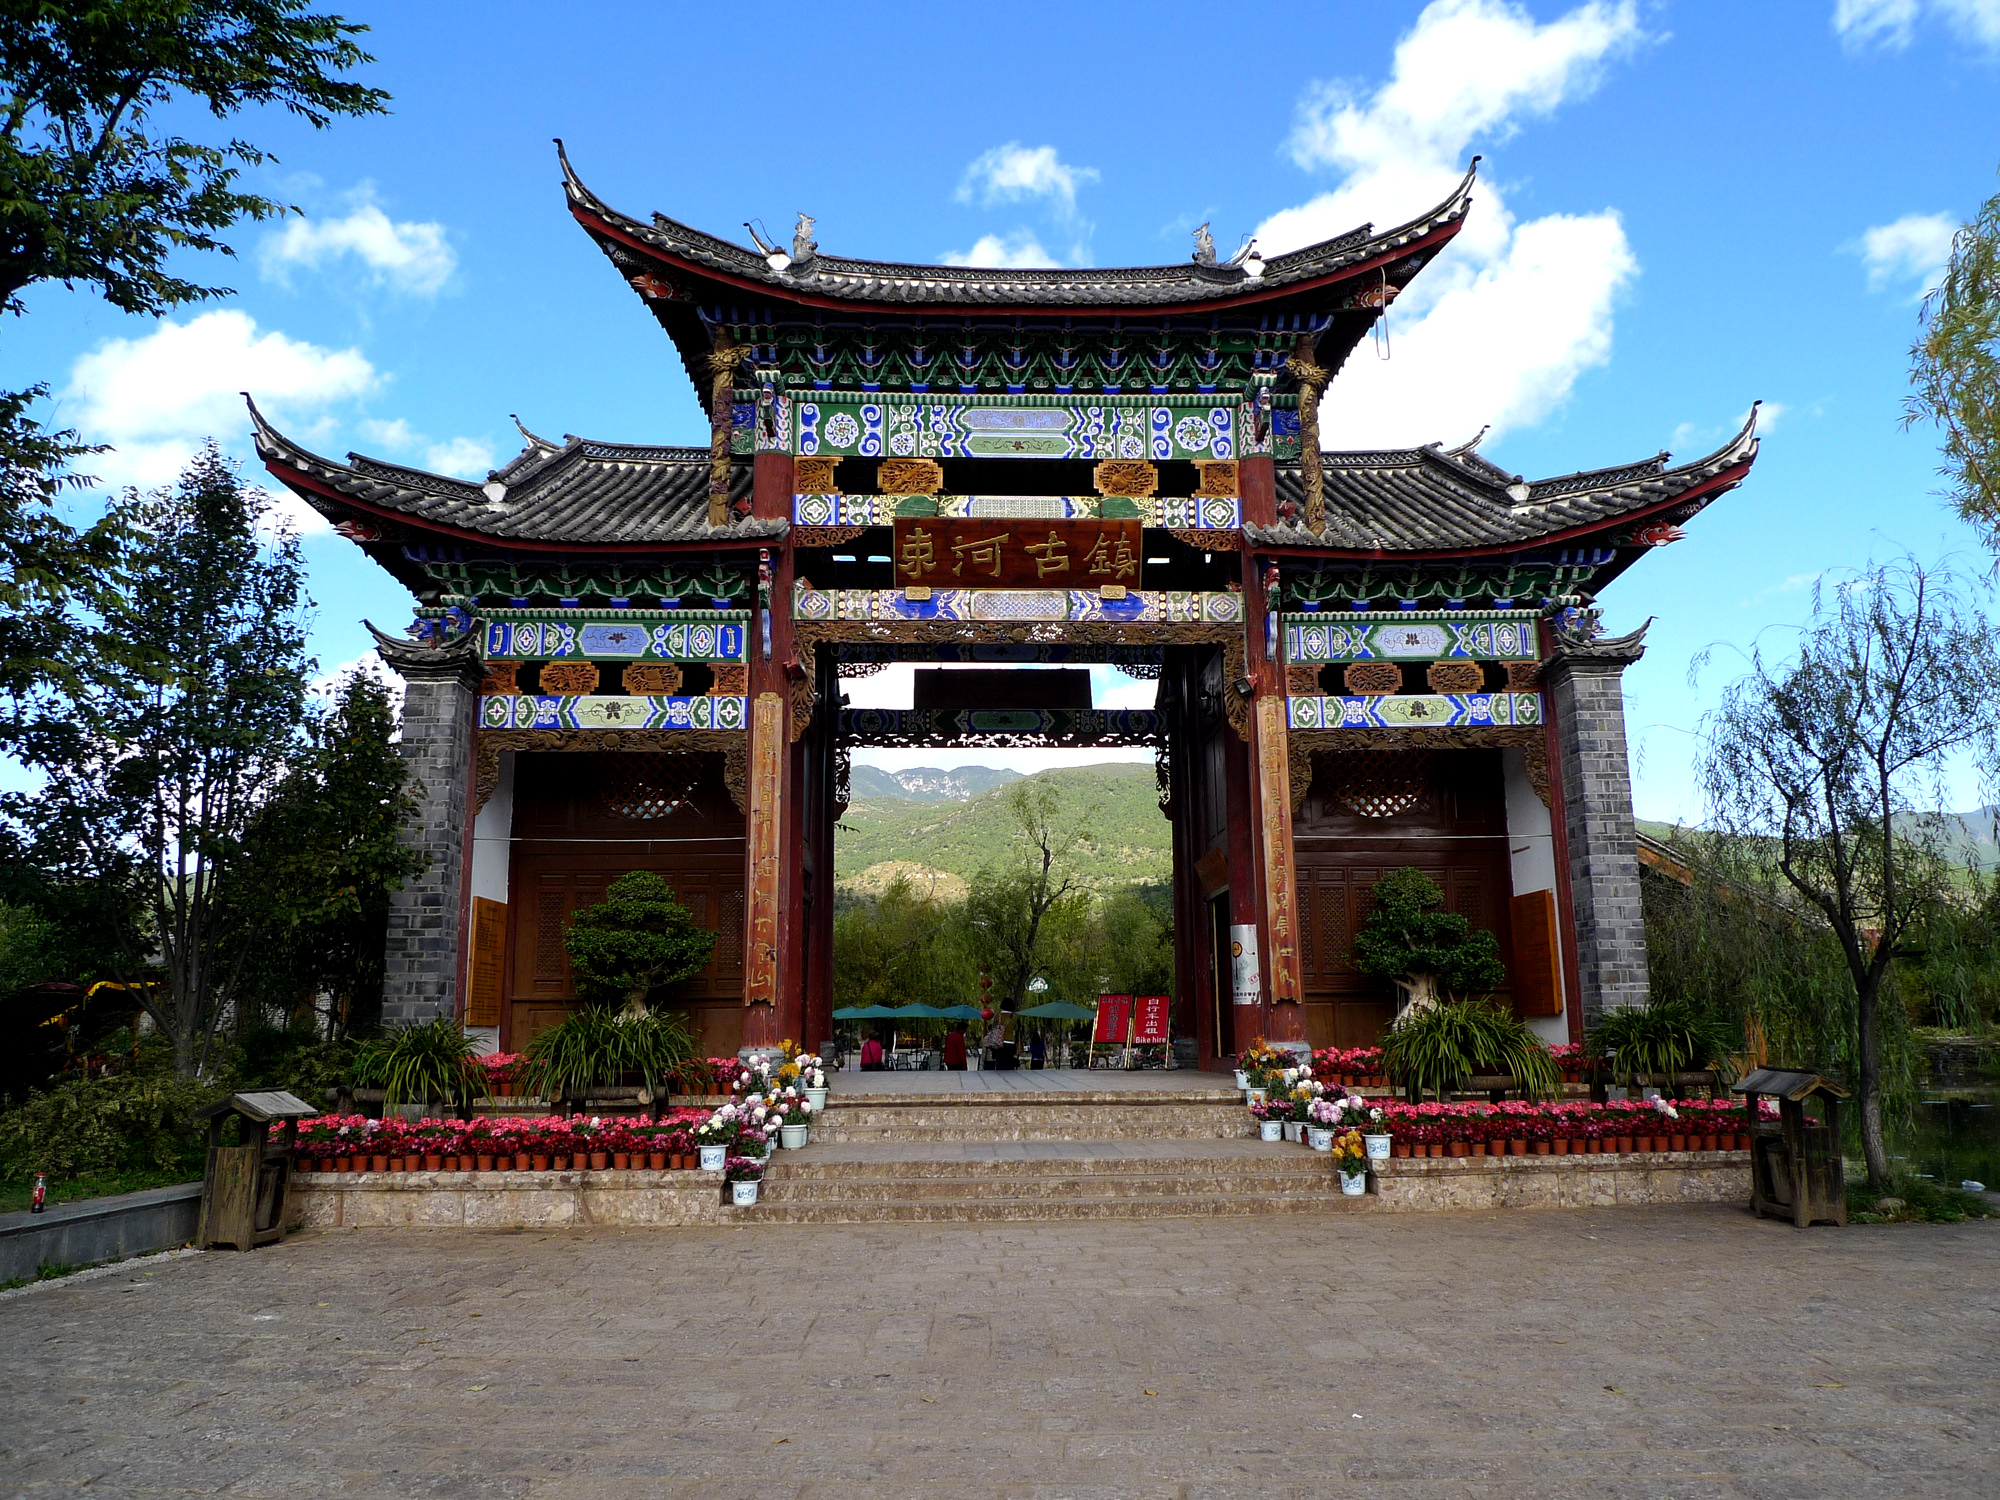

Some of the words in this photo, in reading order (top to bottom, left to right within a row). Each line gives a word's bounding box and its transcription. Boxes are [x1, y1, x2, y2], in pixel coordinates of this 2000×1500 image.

[1144, 999, 1160, 1034] 自行车出租
[1135, 1036, 1151, 1044] Bike
[1151, 1035, 1166, 1044] hire
